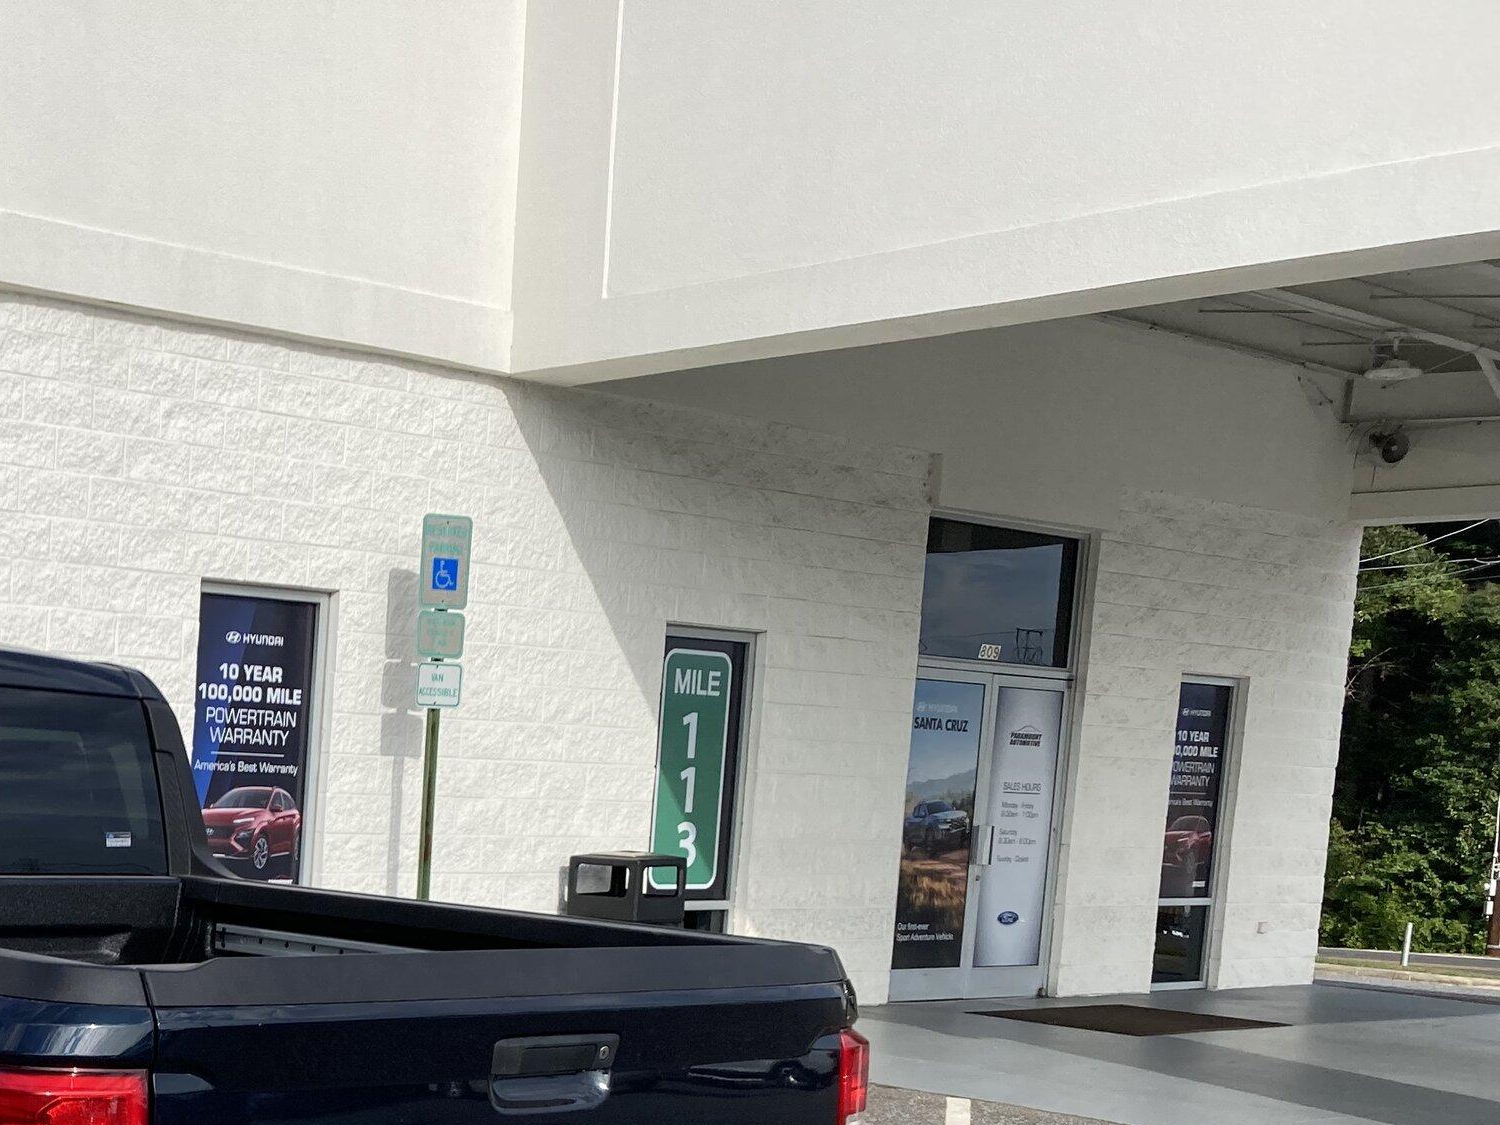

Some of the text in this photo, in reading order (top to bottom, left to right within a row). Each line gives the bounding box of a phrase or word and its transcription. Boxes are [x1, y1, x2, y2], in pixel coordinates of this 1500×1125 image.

[243, 633, 284, 647] HYUNDAI
[980, 643, 1000, 659] 809
[219, 663, 283, 683] 10 YEAR
[674, 668, 722, 697] MILE
[199, 683, 302, 705] 100,000 MILE
[206, 706, 297, 728] POWERTRAIN
[913, 716, 969, 732] SANTA CRUZ
[210, 726, 289, 746] WARRANTY
[1178, 729, 1210, 743] 10 YEAR
[1200, 746, 1219, 758] MILE
[194, 759, 298, 778] America's Best Warranty
[1003, 782, 1041, 792] SALES HOURS
